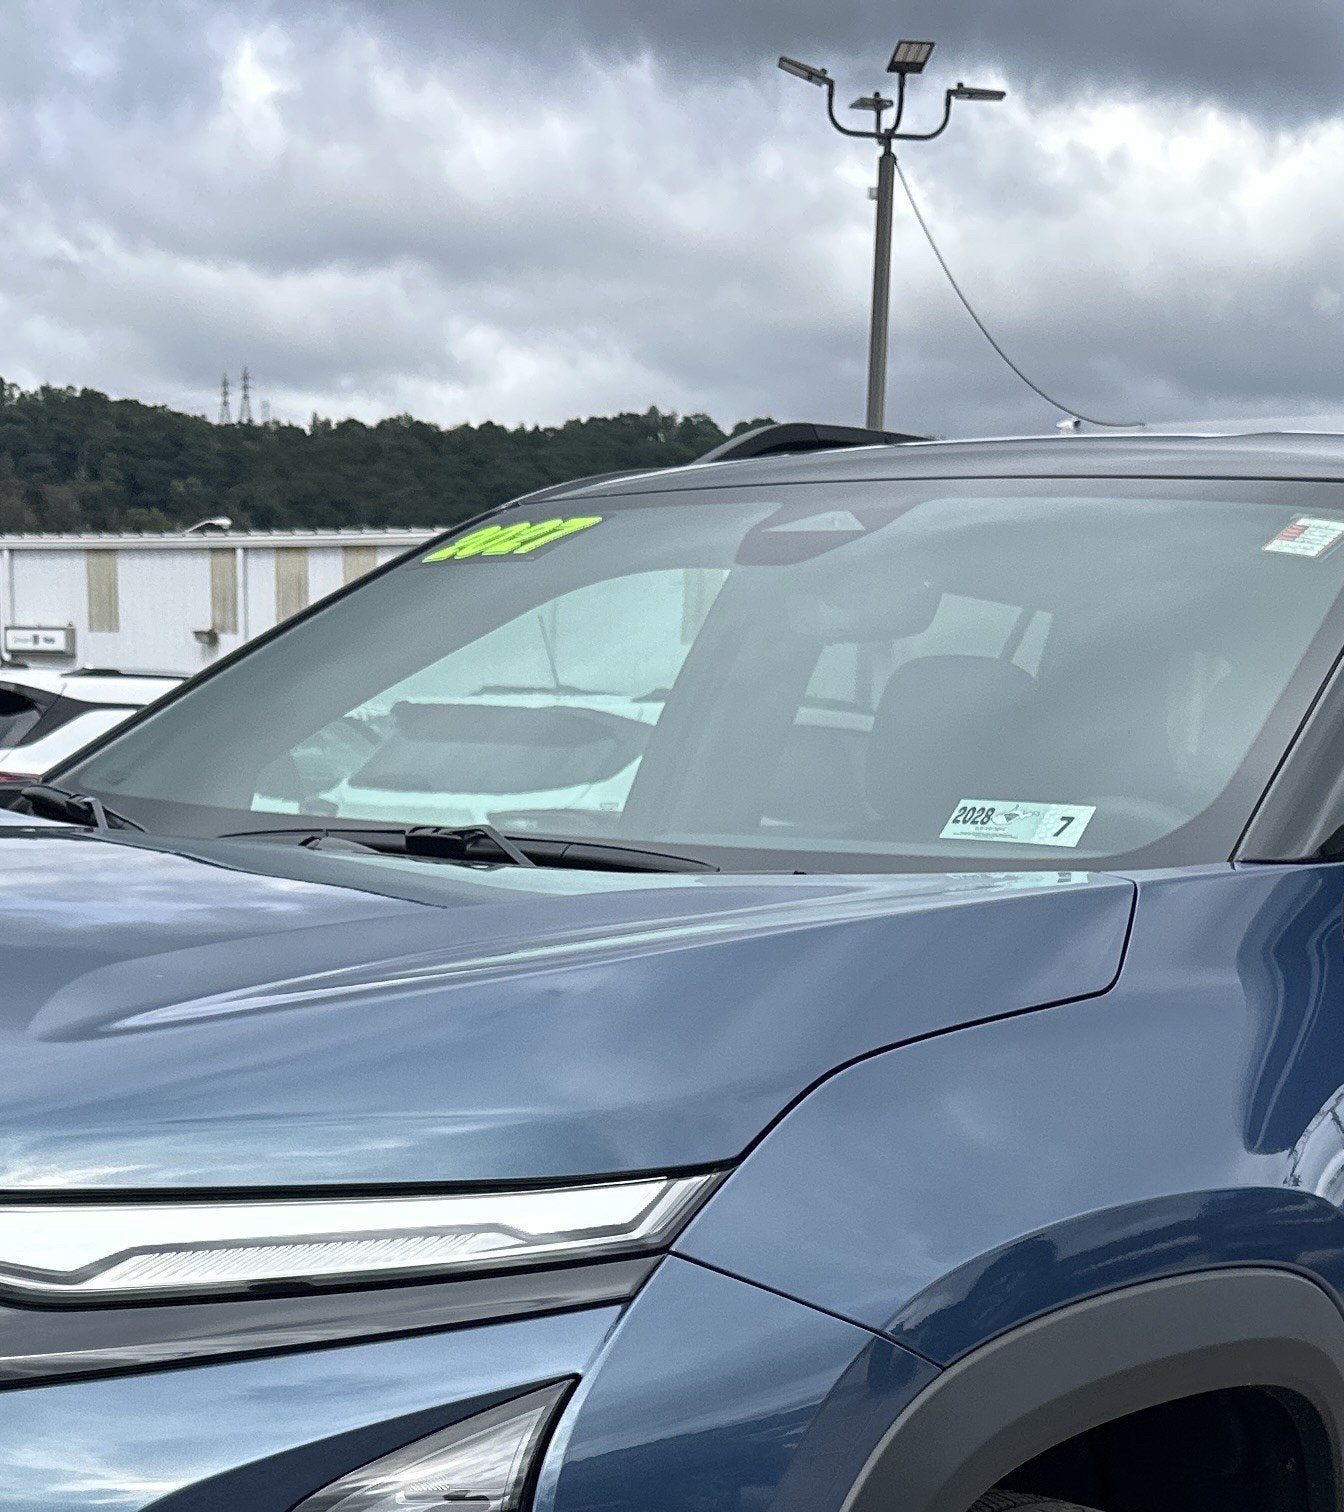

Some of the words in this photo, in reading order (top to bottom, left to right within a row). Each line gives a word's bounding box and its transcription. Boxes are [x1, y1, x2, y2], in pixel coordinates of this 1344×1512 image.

[422, 516, 603, 563] 2027
[952, 806, 996, 825] 2028
[1053, 816, 1075, 838] 7
